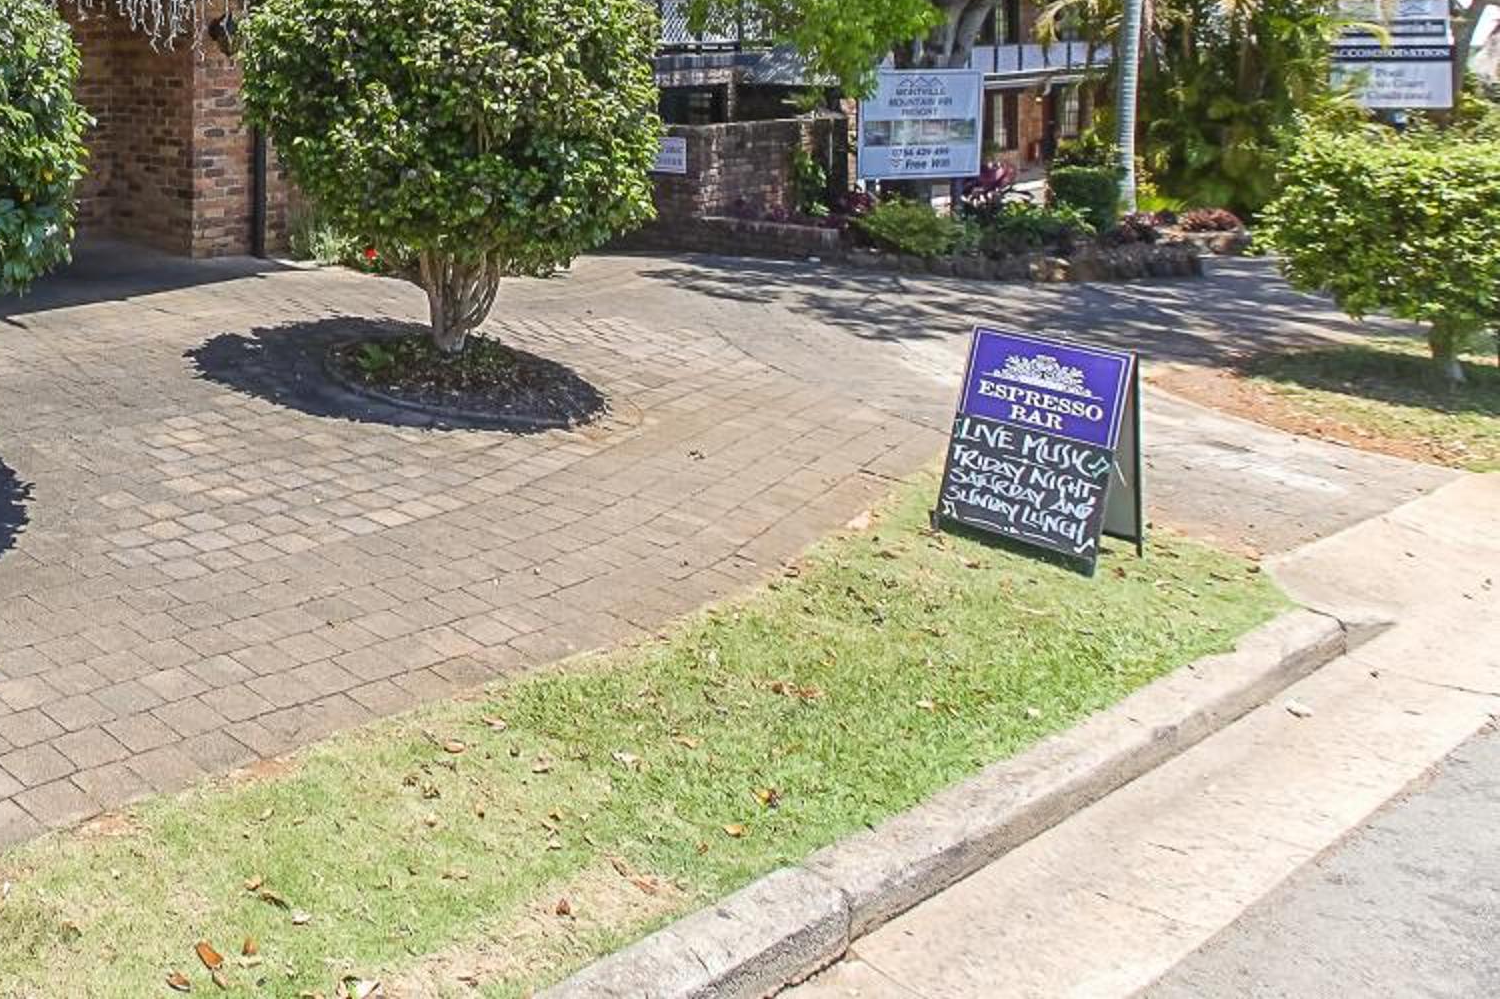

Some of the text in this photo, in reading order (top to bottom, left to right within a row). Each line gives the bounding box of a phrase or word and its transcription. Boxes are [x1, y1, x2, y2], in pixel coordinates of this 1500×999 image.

[978, 379, 1104, 422] ESPRESSO
[1009, 404, 1063, 430] BAR
[953, 444, 1026, 484] FRIDAY
[960, 417, 1093, 478] LIVE MUSIC
[945, 485, 1021, 523] SUNDAY
[950, 467, 1094, 520] SATURDAY AND
